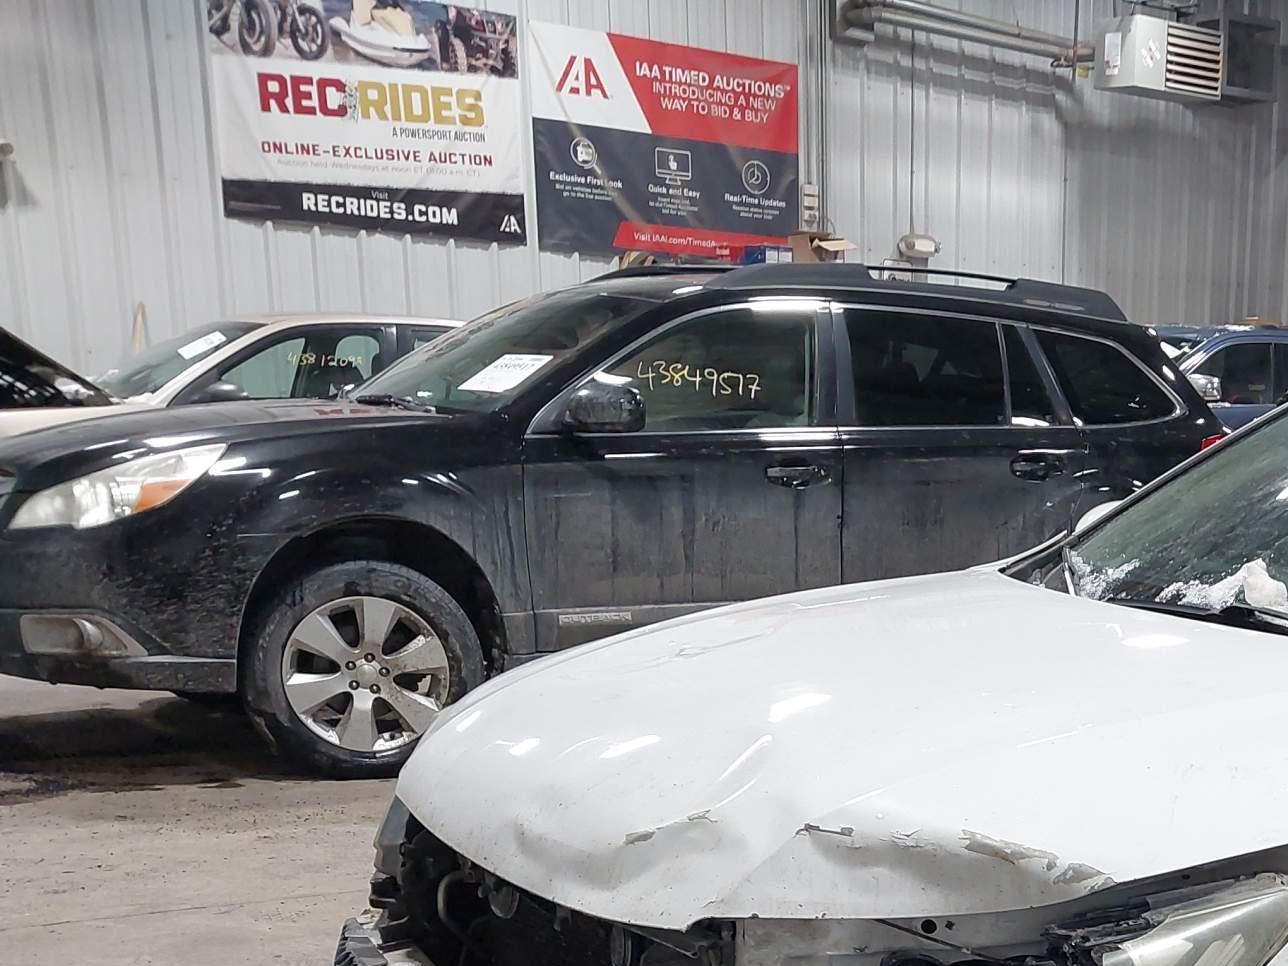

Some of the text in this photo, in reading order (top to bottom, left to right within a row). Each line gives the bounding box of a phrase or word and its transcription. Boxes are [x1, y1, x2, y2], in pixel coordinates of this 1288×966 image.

[635, 60, 661, 80] IAA
[663, 66, 709, 87] TIMED
[257, 72, 486, 127] REC RIDES
[653, 81, 776, 112] INTRODUCING A NEW
[661, 97, 768, 123] WAY TO BID & BUY
[392, 127, 486, 144] A POWERSPORT AUCTION
[261, 141, 493, 167] ONLINE-EXCLUSIVE AUCTION
[549, 171, 586, 184] Exclusive
[371, 189, 389, 201] Visit
[648, 184, 667, 195] Quick
[669, 187, 682, 196] and
[683, 188, 701, 200] Easy
[724, 193, 786, 209] Real-Time Updates
[302, 192, 459, 226] RECRIDES.COM
[634, 231, 651, 242] Visit
[637, 361, 761, 399] 43849517
